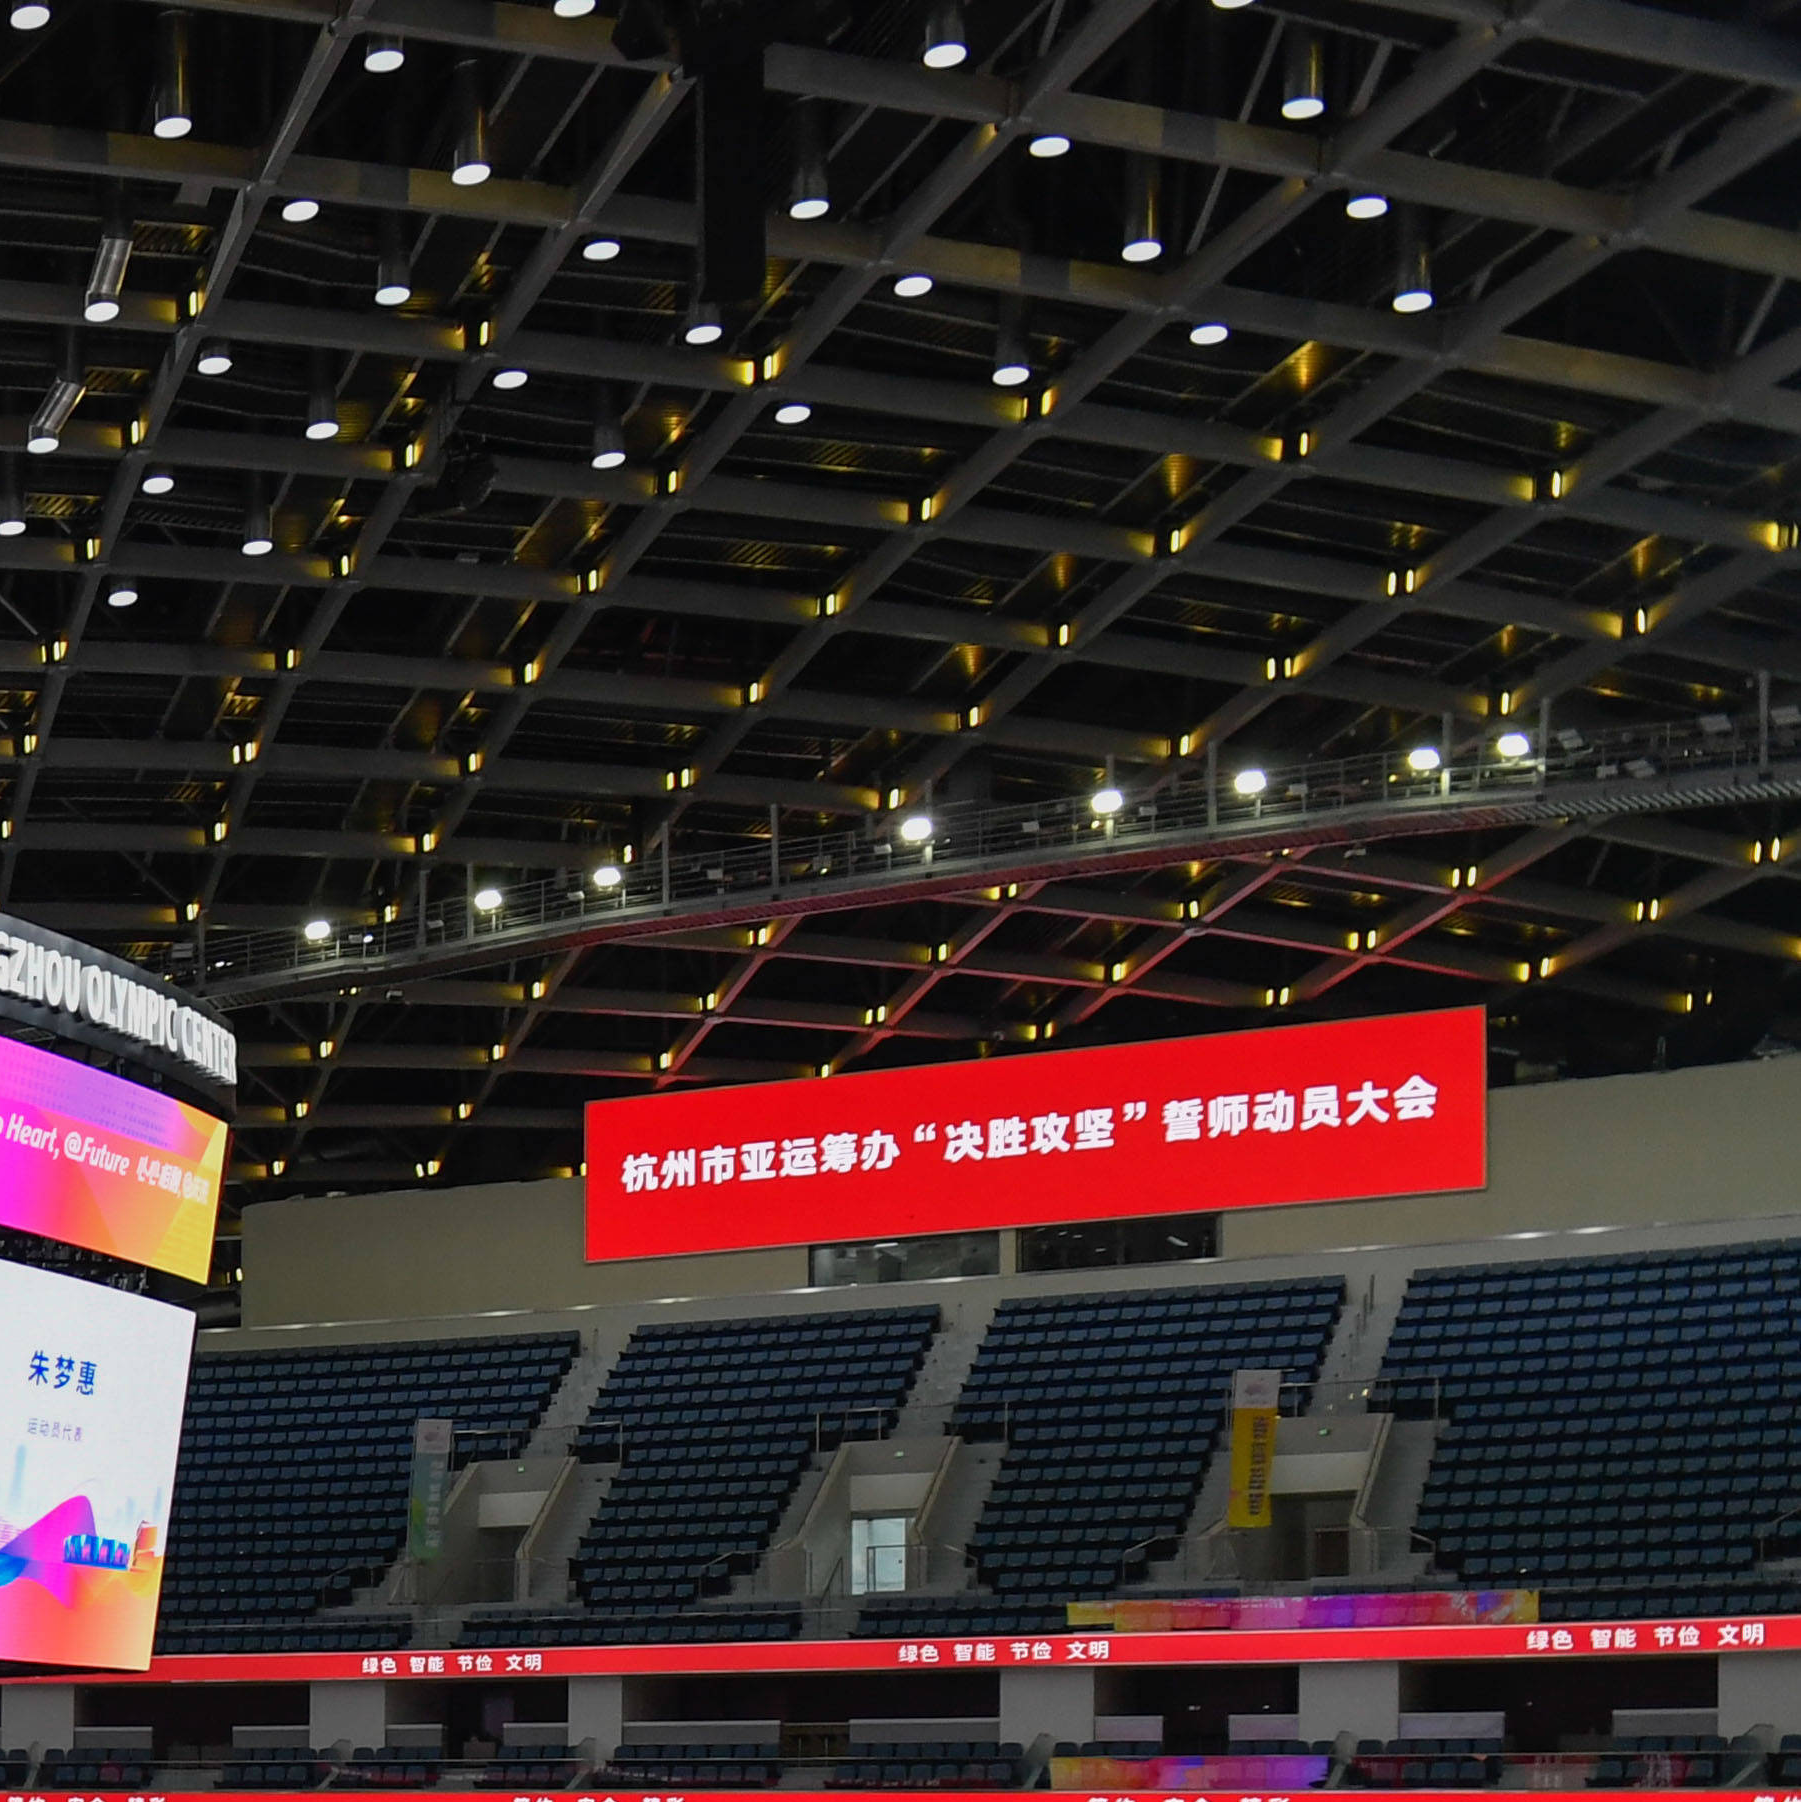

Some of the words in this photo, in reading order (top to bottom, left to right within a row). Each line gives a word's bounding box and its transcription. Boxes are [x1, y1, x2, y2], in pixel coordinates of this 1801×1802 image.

[81, 965, 178, 1052] OLYMPIC
[177, 1006, 237, 1085] CENTER
[6, 1113, 59, 1160] Heart,
[64, 1130, 130, 1176] @Future
[620, 1074, 1439, 1194] 杭州市亚运筹办“决胜攻坚”誓师动员大会
[28, 1350, 97, 1396] 朱梦惠
[899, 1643, 939, 1663] 绿色
[953, 1642, 996, 1662] 智能
[1067, 1639, 1110, 1661] 文明
[1527, 1629, 1574, 1650] 绿色
[1591, 1627, 1637, 1649] 智能
[1718, 1623, 1764, 1645] 文明
[506, 1653, 542, 1672] 文明
